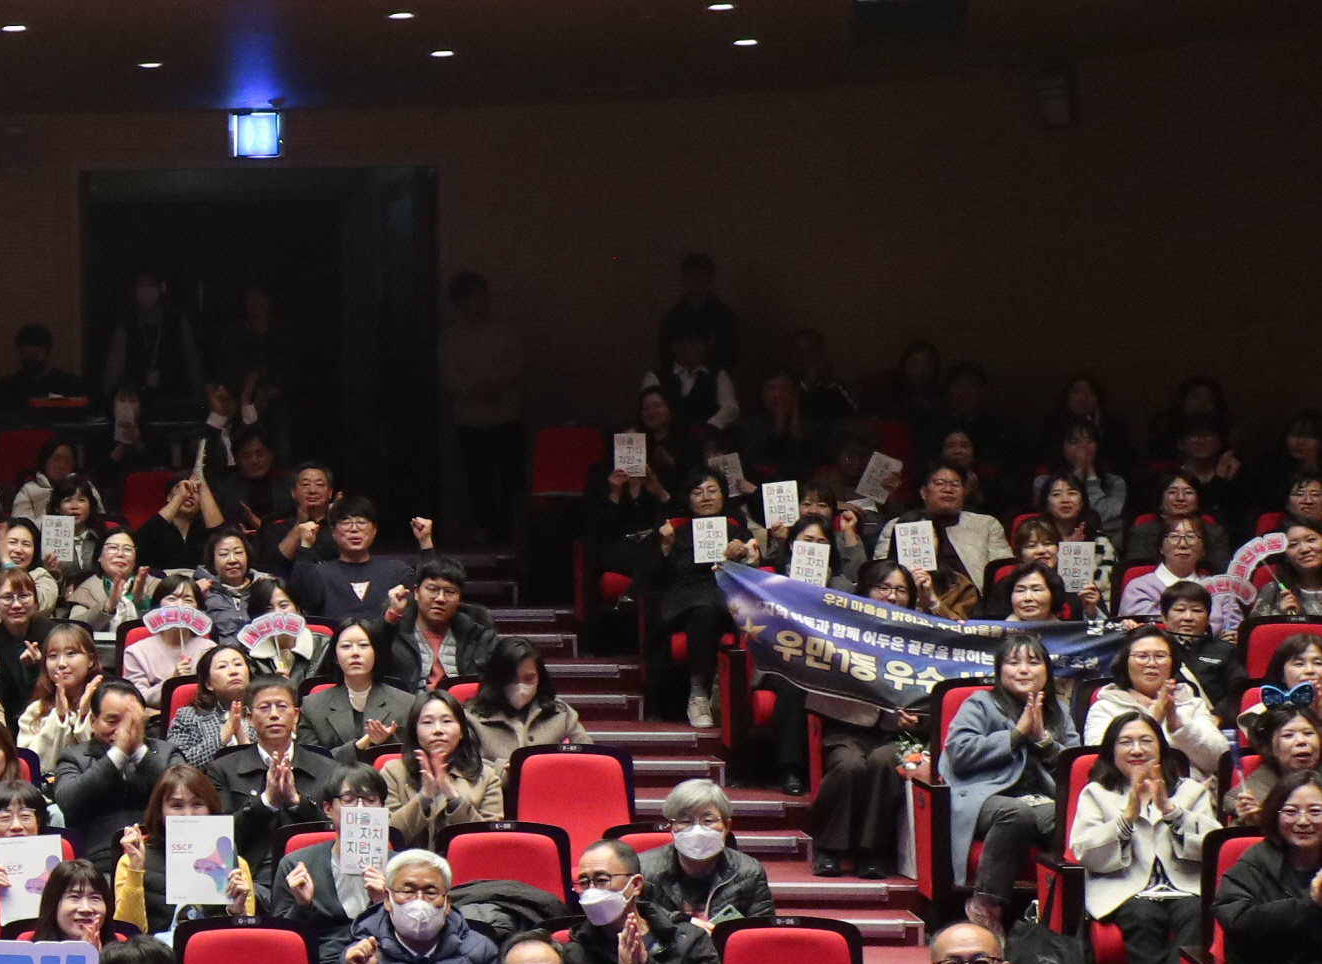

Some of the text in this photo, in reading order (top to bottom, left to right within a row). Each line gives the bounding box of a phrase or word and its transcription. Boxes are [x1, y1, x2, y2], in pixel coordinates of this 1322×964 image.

[766, 486, 784, 495] 마을
[777, 495, 794, 503] 자치
[769, 505, 786, 514] 지원
[899, 527, 918, 536] 마을
[910, 537, 929, 545] 자치
[797, 546, 815, 556] 마을
[902, 548, 921, 557] 지원
[806, 557, 824, 567] 자치
[795, 567, 813, 577] 지원
[823, 593, 848, 608] 우리
[851, 601, 888, 619] 마을을
[833, 623, 859, 642] 함께
[863, 632, 904, 652] 어두운
[908, 641, 948, 661] 골목을
[953, 648, 995, 666] 밝히는
[773, 630, 946, 694] 우만1동 우수
[346, 812, 370, 825] 마을
[359, 828, 383, 839] 자치
[171, 843, 193, 851] SSCF
[346, 841, 370, 854] 지원
[358, 856, 382, 869] 센터
[6, 864, 23, 872] SCF
